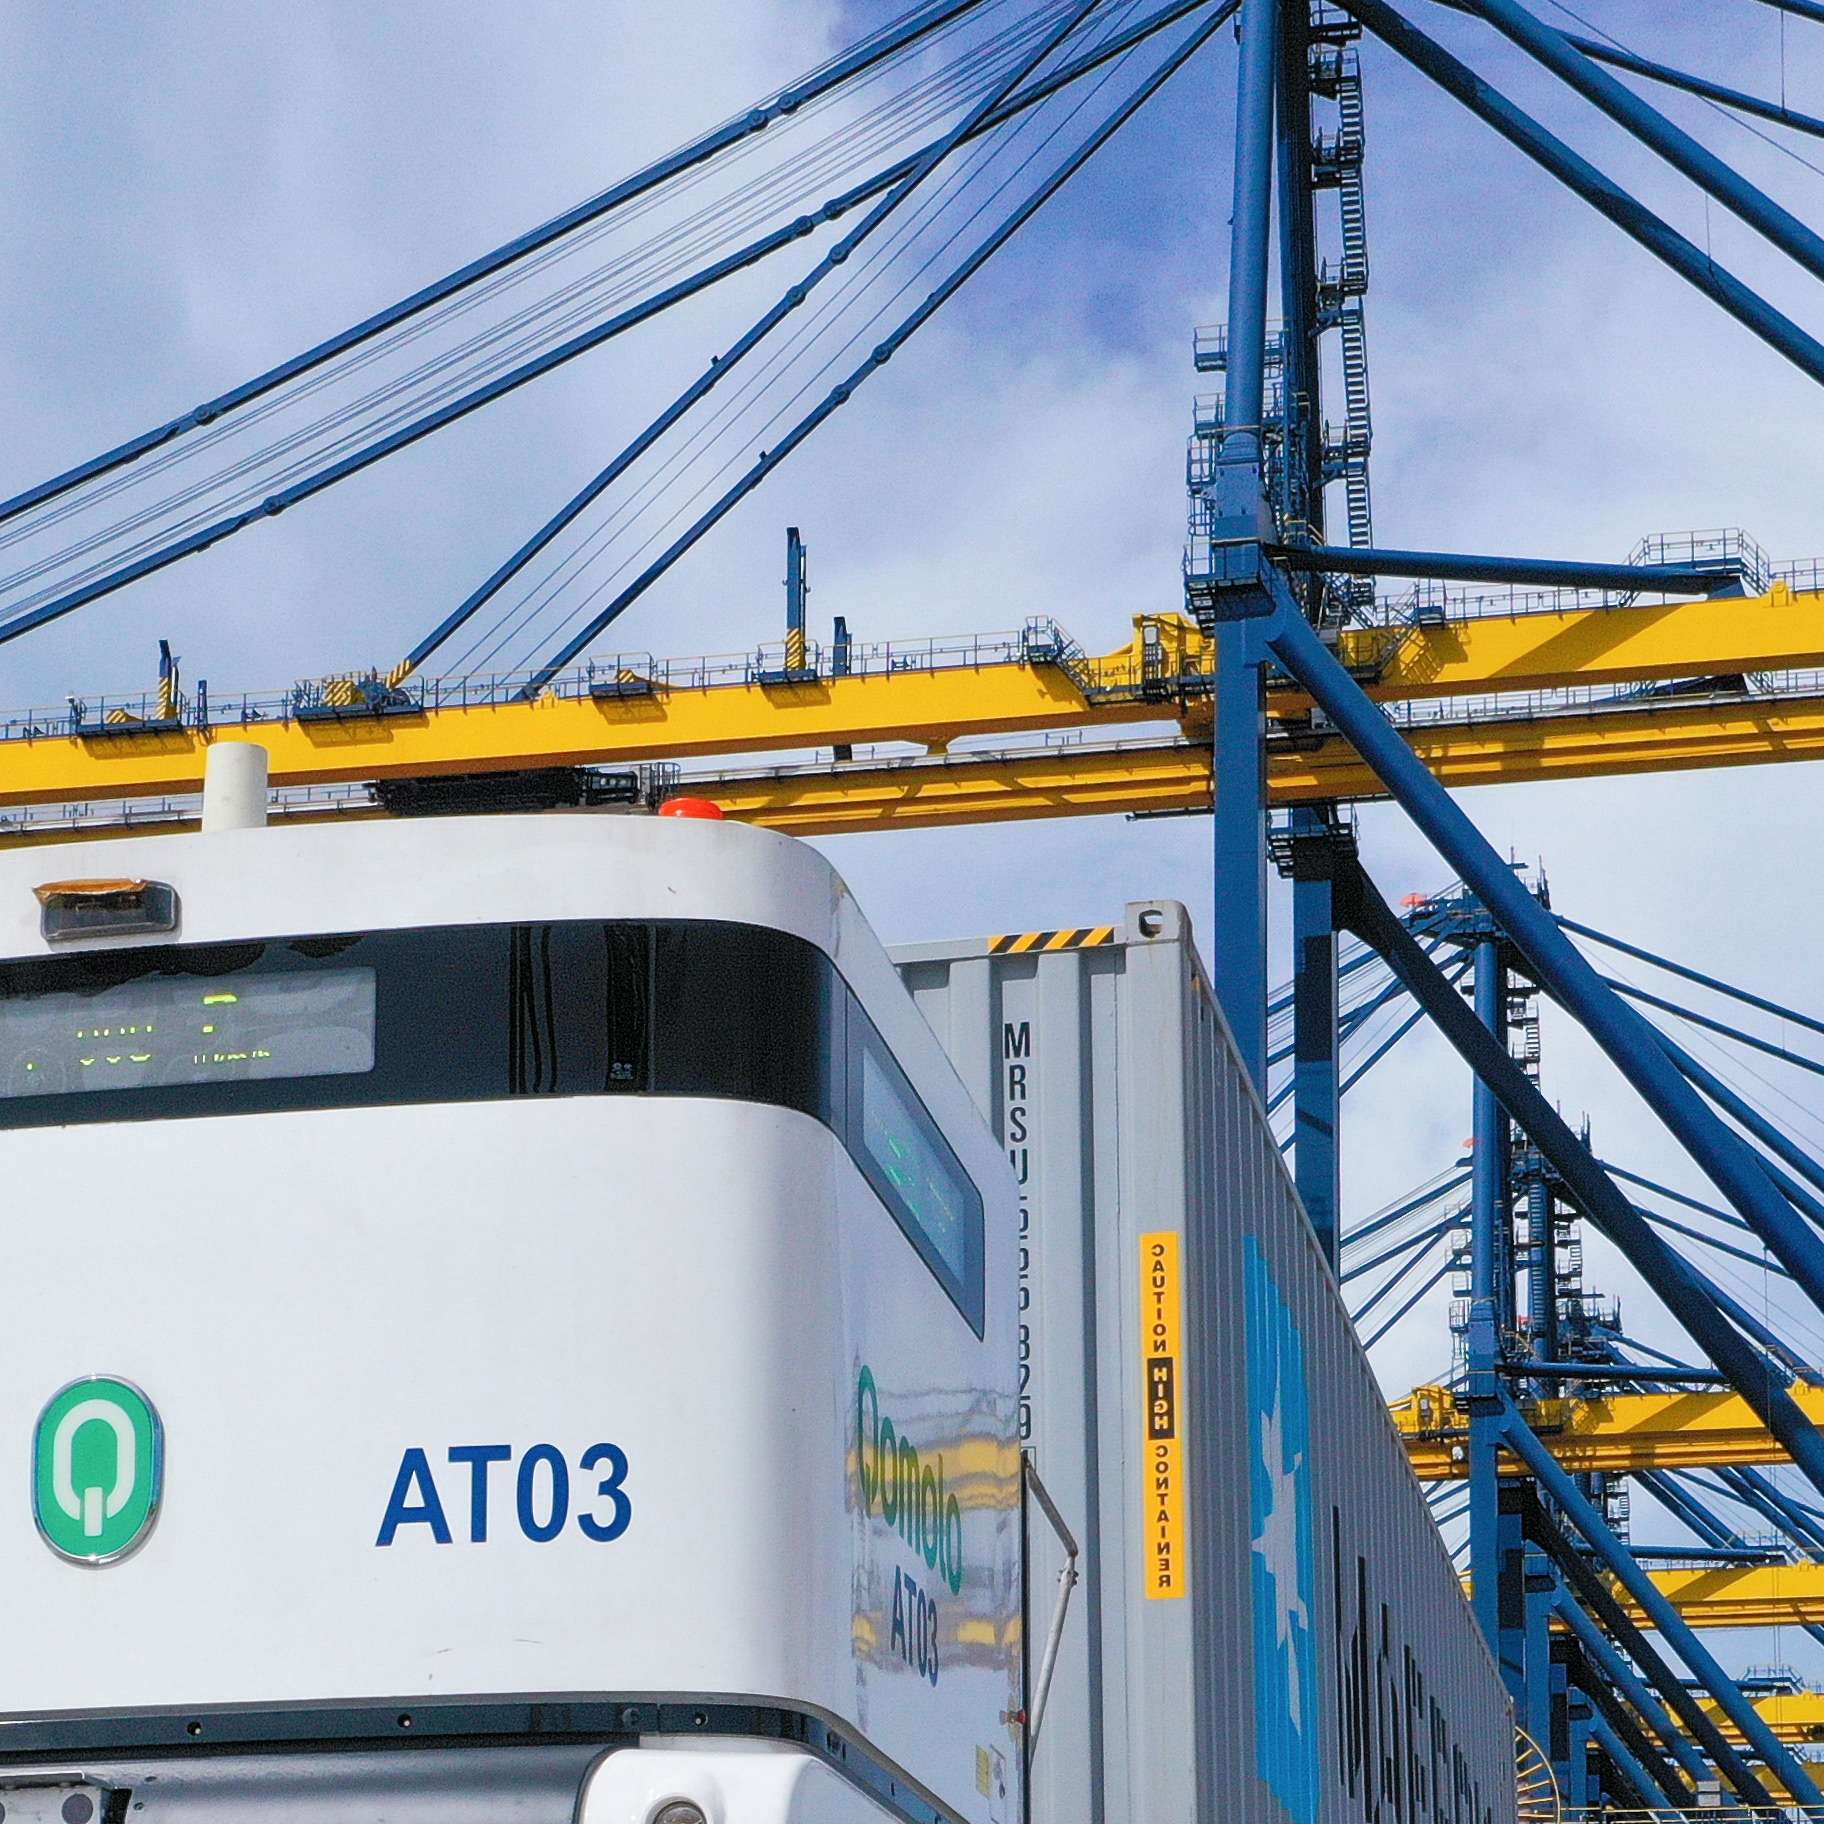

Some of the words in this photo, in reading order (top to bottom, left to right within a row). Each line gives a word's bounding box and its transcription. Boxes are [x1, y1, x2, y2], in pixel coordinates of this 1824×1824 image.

[1004, 1021, 1030, 1185] MRSU
[375, 1442, 633, 1547] AT03
[857, 1364, 962, 1596] Qomolo
[890, 1564, 939, 1688] AT03
